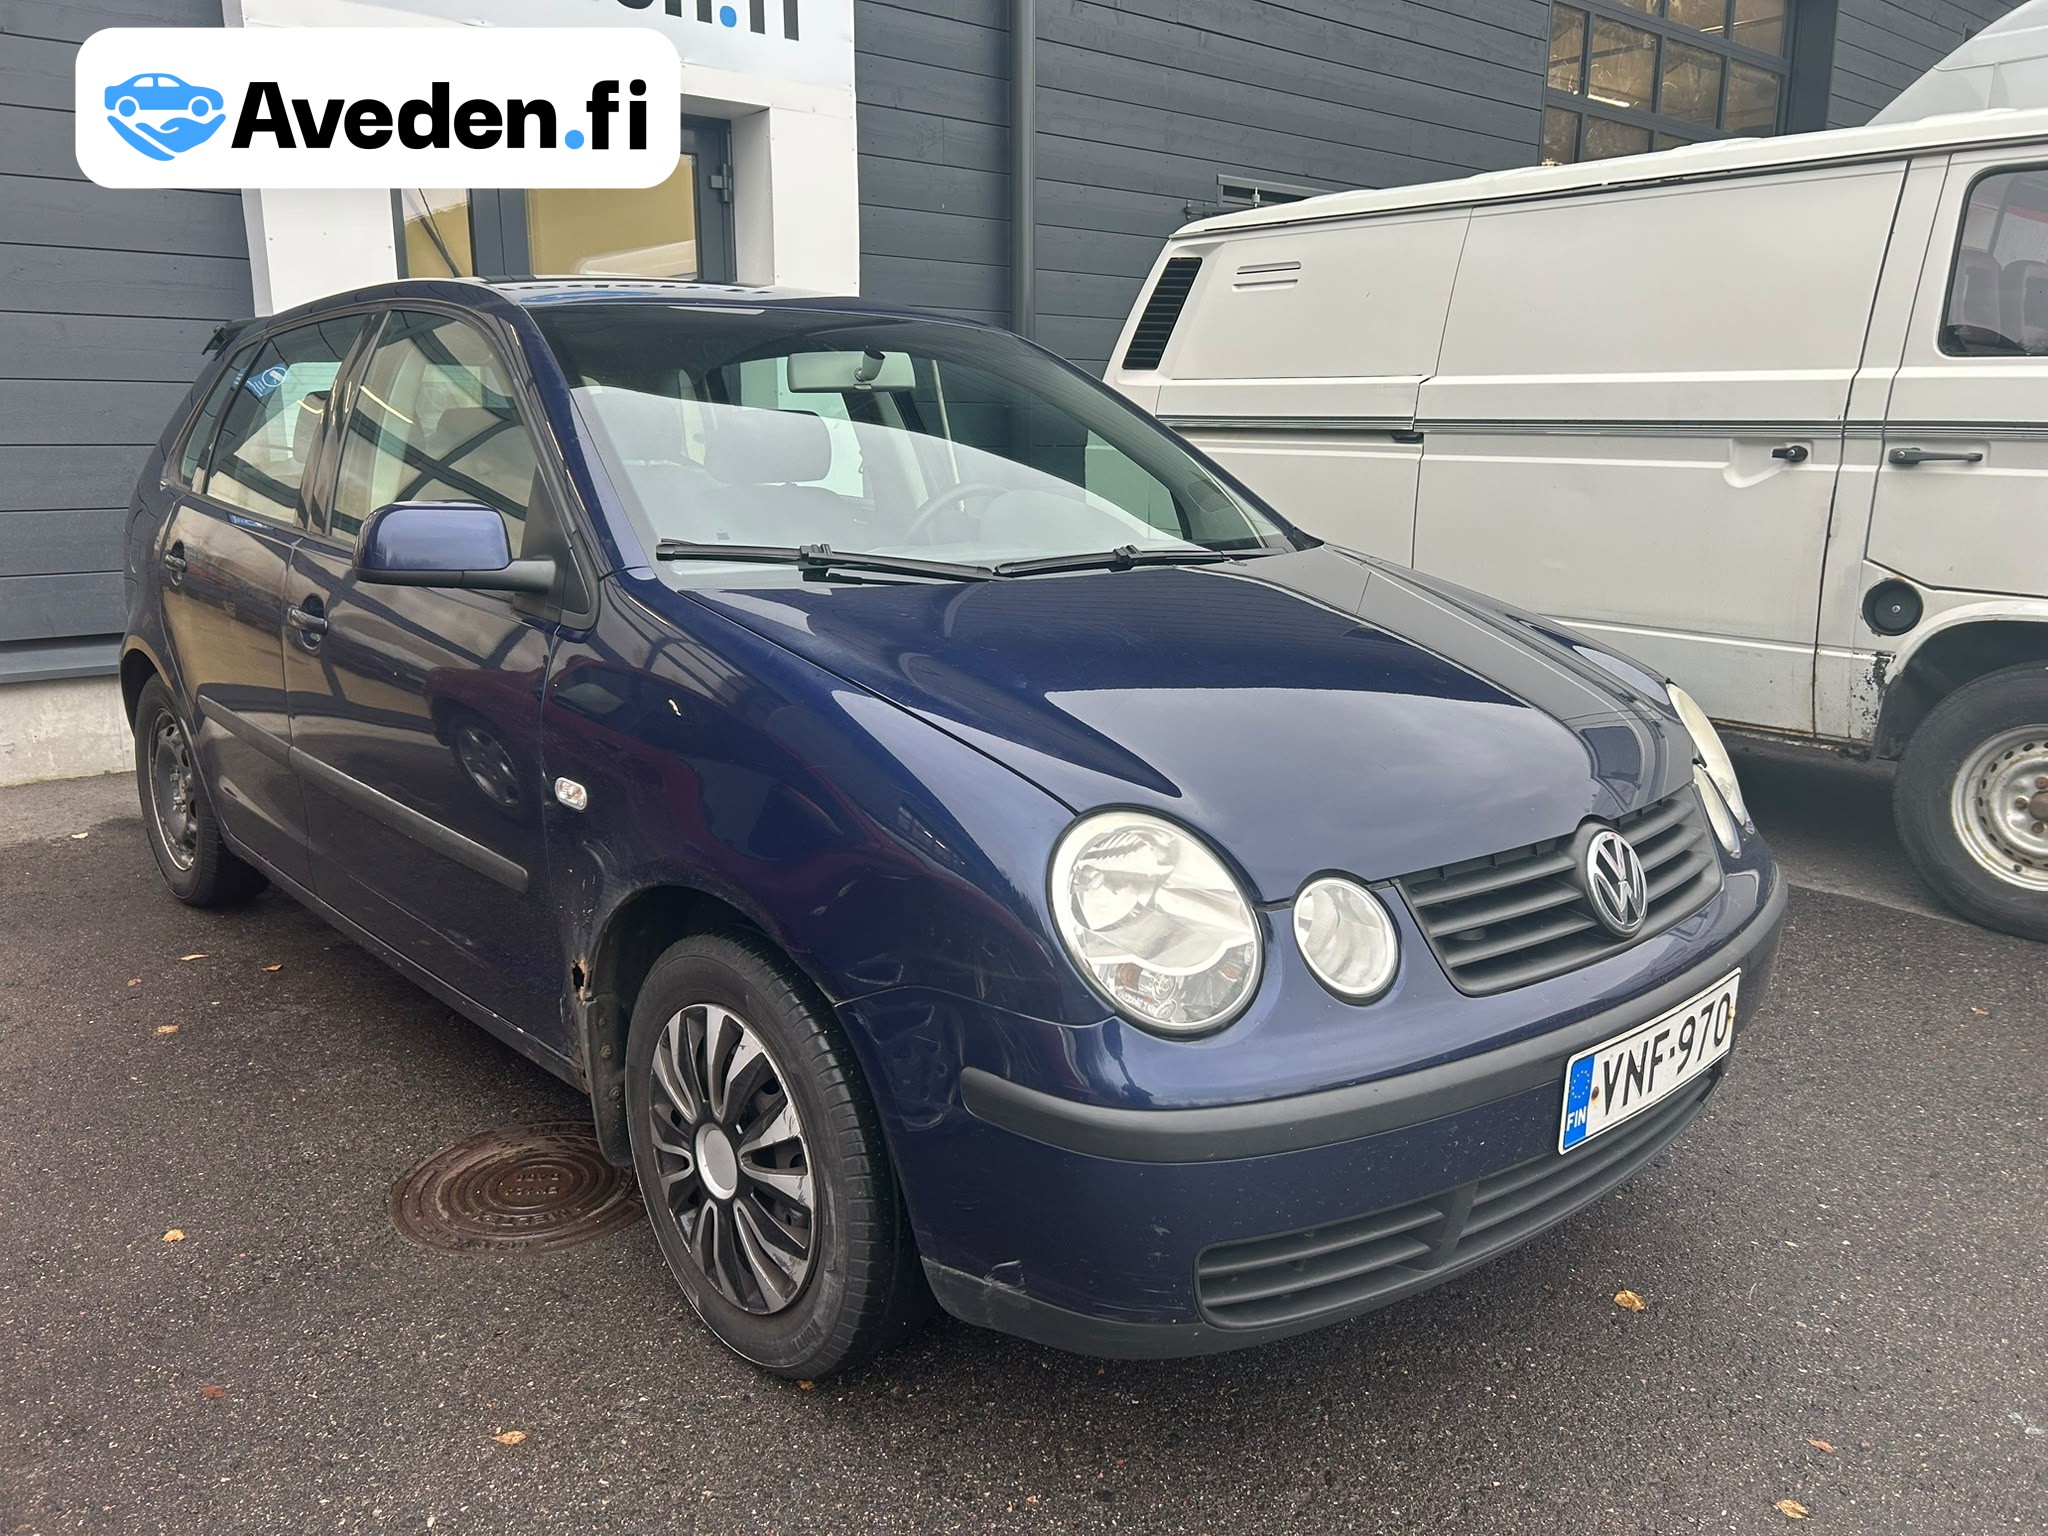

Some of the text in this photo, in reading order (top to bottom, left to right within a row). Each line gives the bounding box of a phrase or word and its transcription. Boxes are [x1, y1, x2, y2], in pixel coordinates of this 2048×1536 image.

[1588, 832, 1646, 932] VW
[1603, 992, 1731, 1115] VNF-970
[1566, 1106, 1587, 1132] FIN
